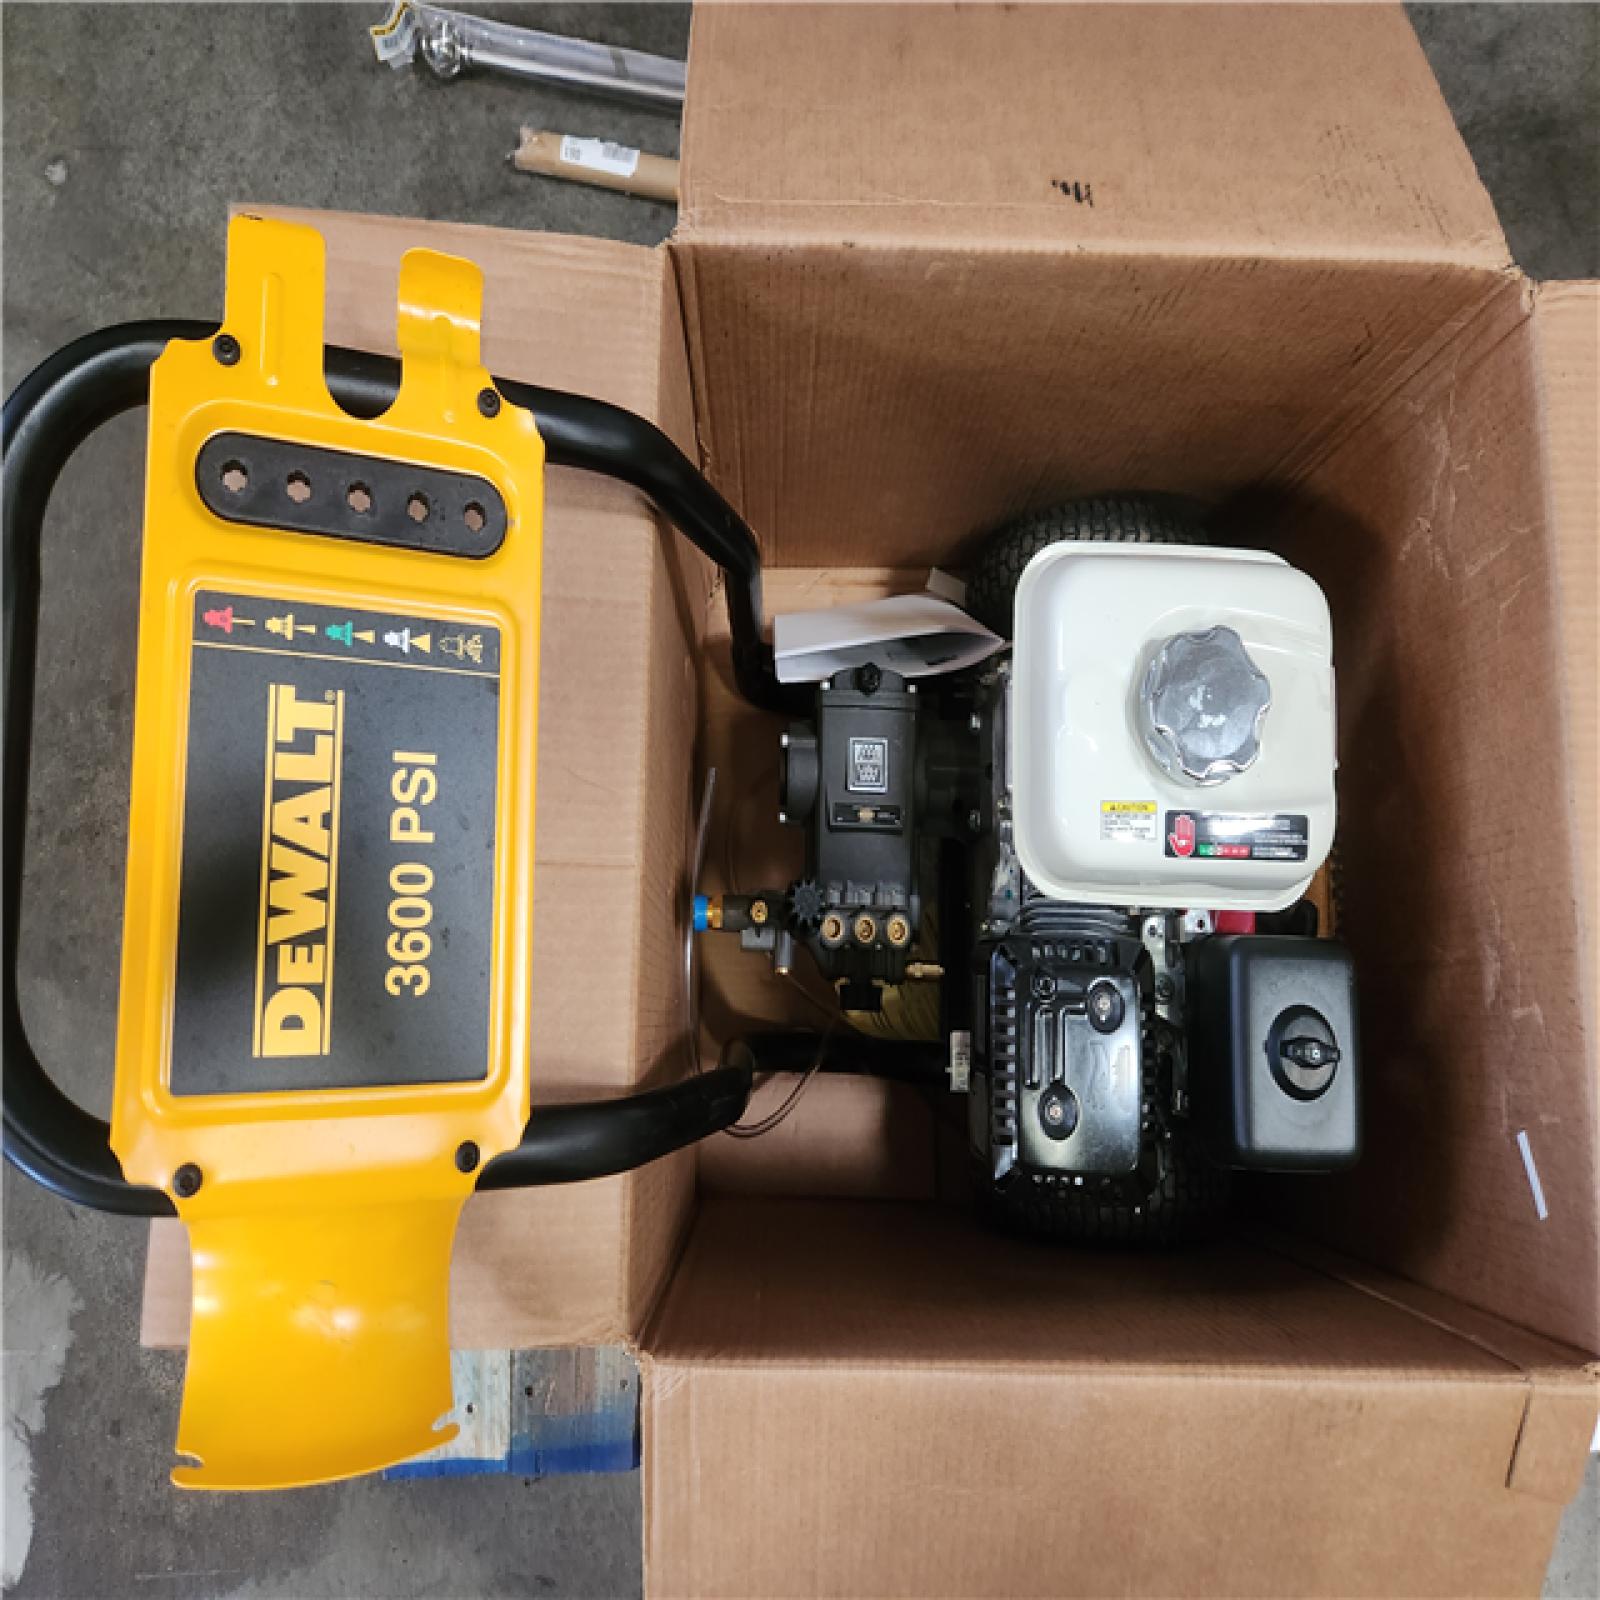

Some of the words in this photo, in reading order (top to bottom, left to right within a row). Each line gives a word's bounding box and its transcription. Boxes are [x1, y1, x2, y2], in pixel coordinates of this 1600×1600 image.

[390, 751, 438, 843] PSI
[261, 685, 336, 1056] DEWALT
[385, 863, 435, 997] 3600
